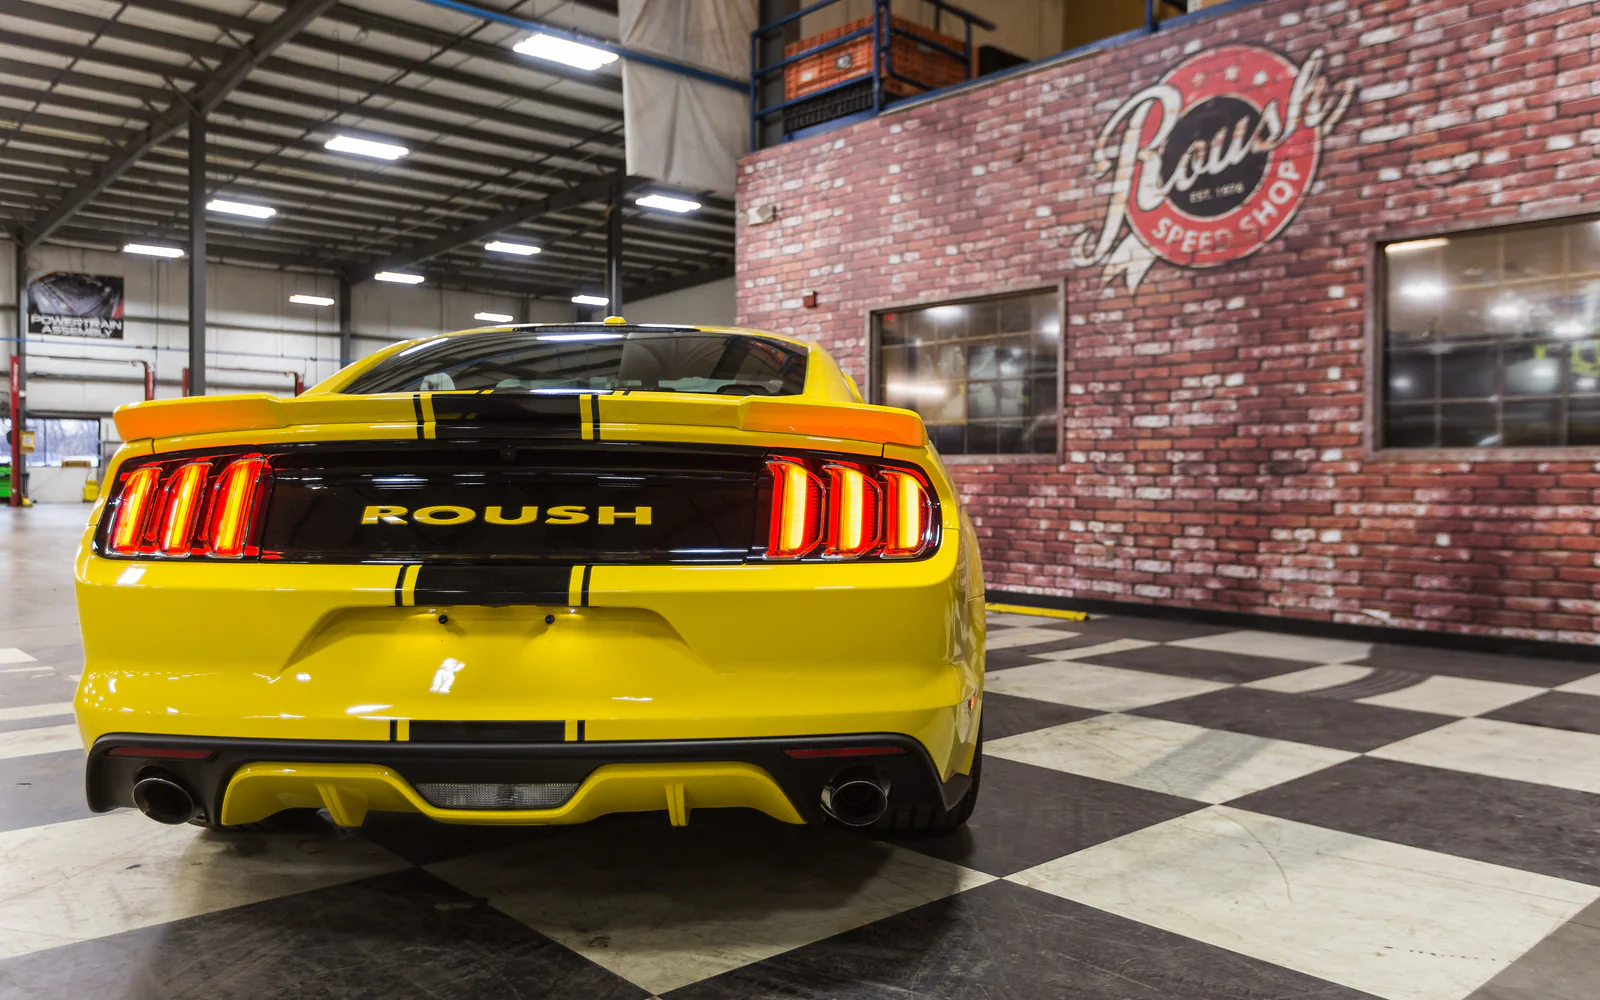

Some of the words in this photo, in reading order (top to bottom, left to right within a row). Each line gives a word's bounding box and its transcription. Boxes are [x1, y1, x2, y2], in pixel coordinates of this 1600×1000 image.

[1071, 48, 1357, 270] Roush
[1151, 217, 1232, 254] SPEED
[1239, 160, 1300, 234] SHOP
[30, 314, 122, 330] POWERTRAIN
[41, 325, 113, 338] ASSEMBLY
[361, 505, 652, 525] ROUSH
